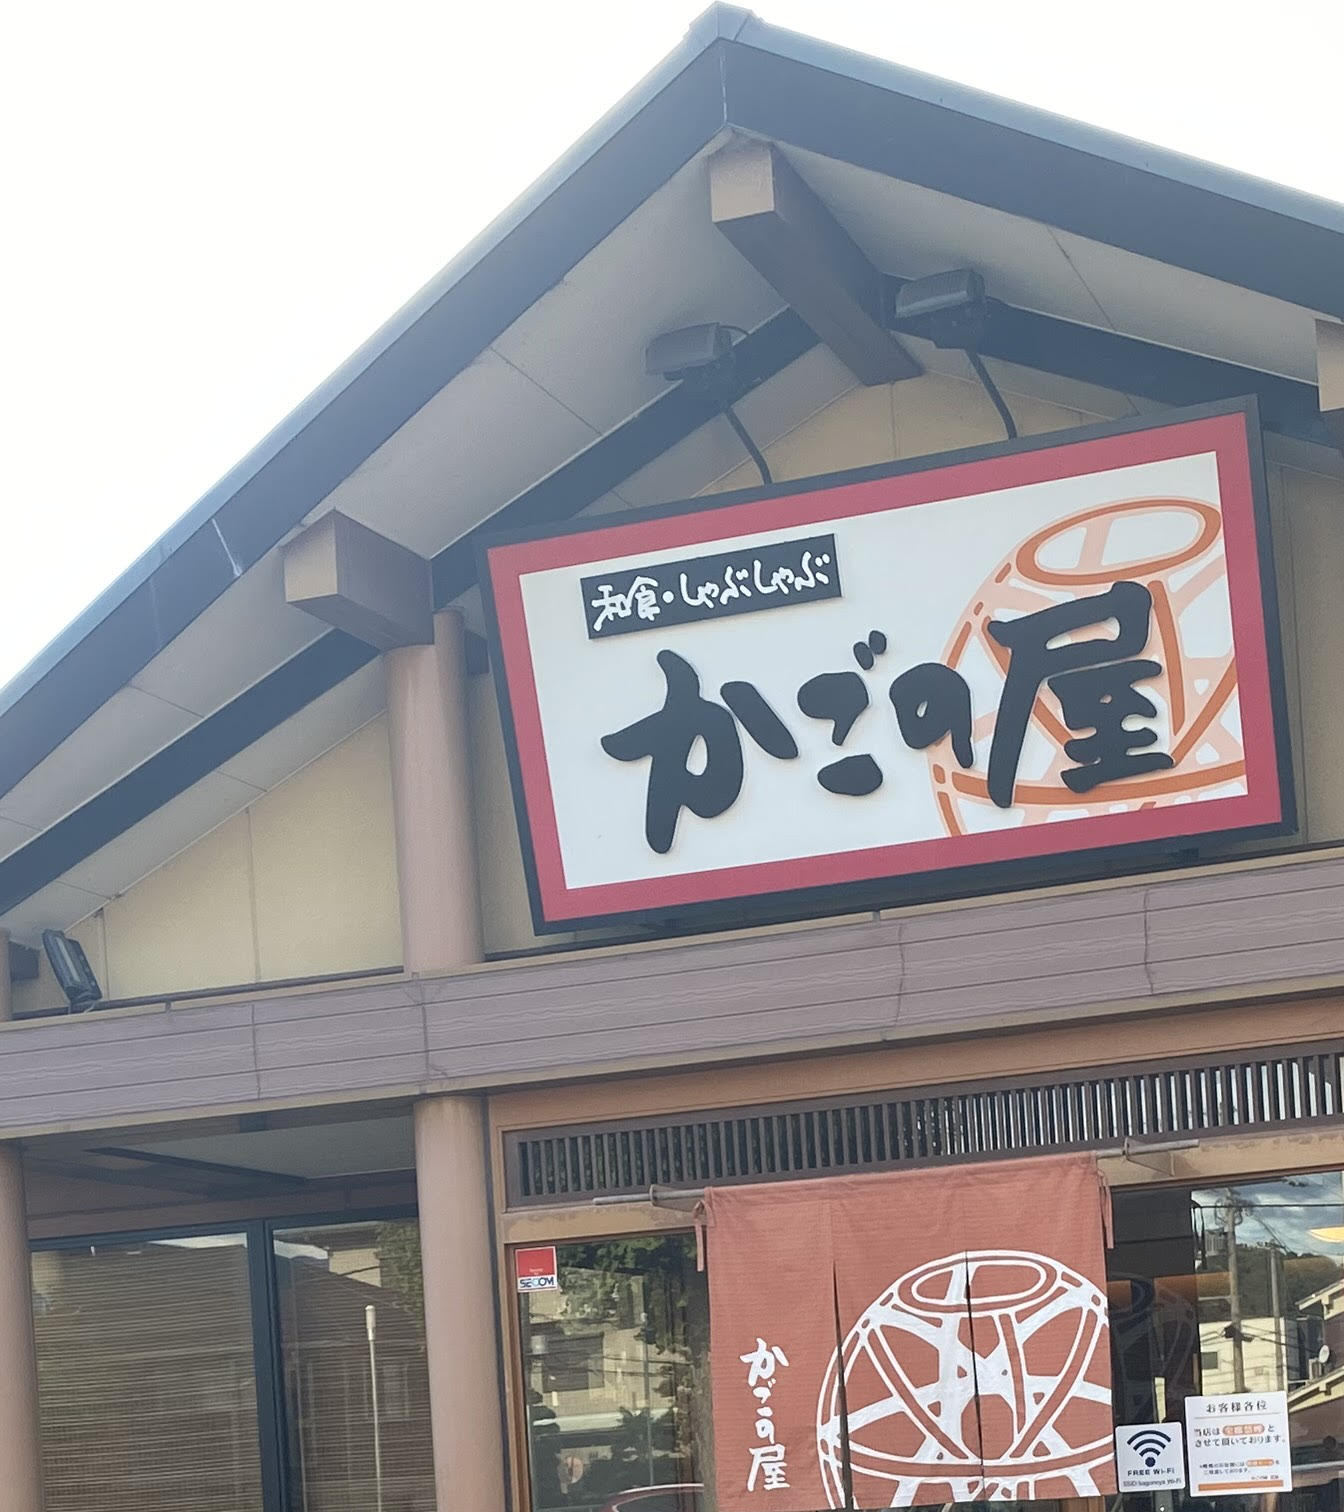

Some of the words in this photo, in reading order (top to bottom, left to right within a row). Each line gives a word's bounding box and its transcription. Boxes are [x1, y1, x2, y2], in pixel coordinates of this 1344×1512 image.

[590, 550, 832, 631] 和食・しゃぶしゃぶ
[601, 580, 1173, 855] かごの屋
[520, 1277, 555, 1288] SECOM
[739, 1337, 791, 1493] かごの屋
[1206, 1400, 1268, 1414] お客様各位
[1127, 1469, 1151, 1477] FREE
